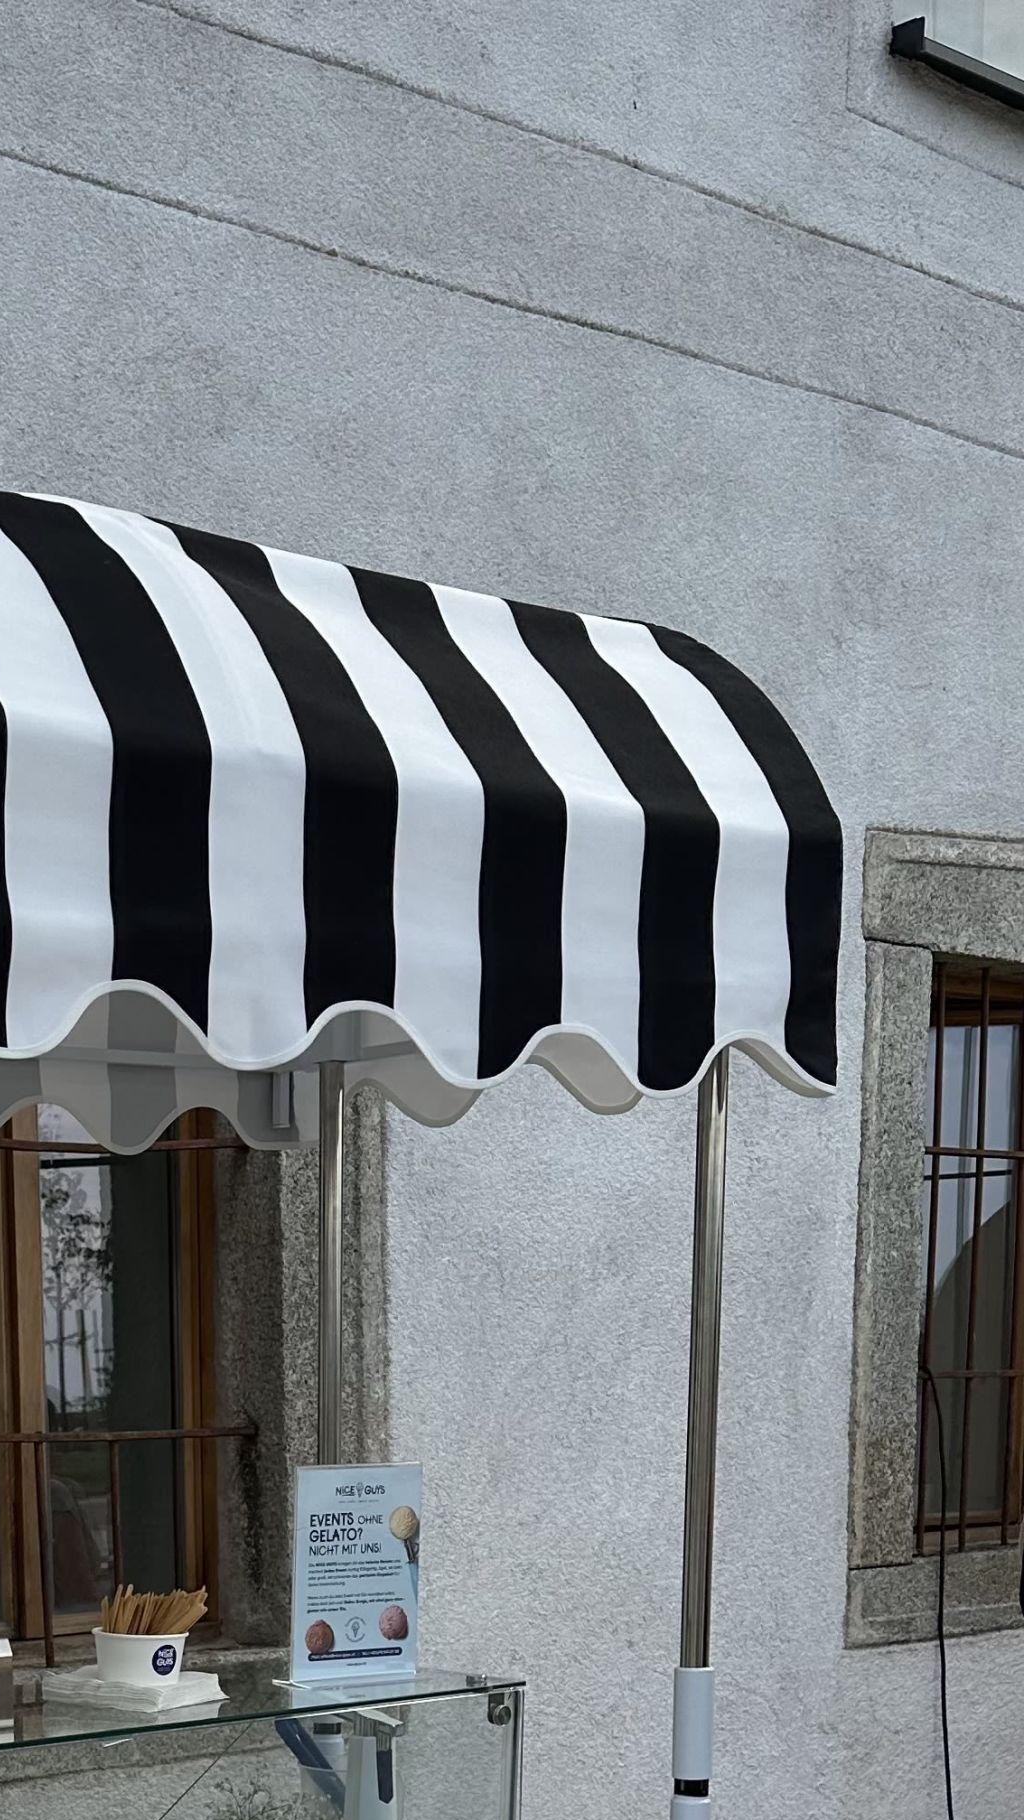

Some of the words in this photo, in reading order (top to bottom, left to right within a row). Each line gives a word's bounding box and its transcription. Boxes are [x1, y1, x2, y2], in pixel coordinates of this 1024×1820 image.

[309, 1512, 354, 1528] EVENTS
[357, 1514, 384, 1526] OHNE
[309, 1528, 364, 1543] GELATO?
[308, 1546, 340, 1558] NICHT
[341, 1544, 358, 1556] MIT
[360, 1542, 382, 1554] UNS!
